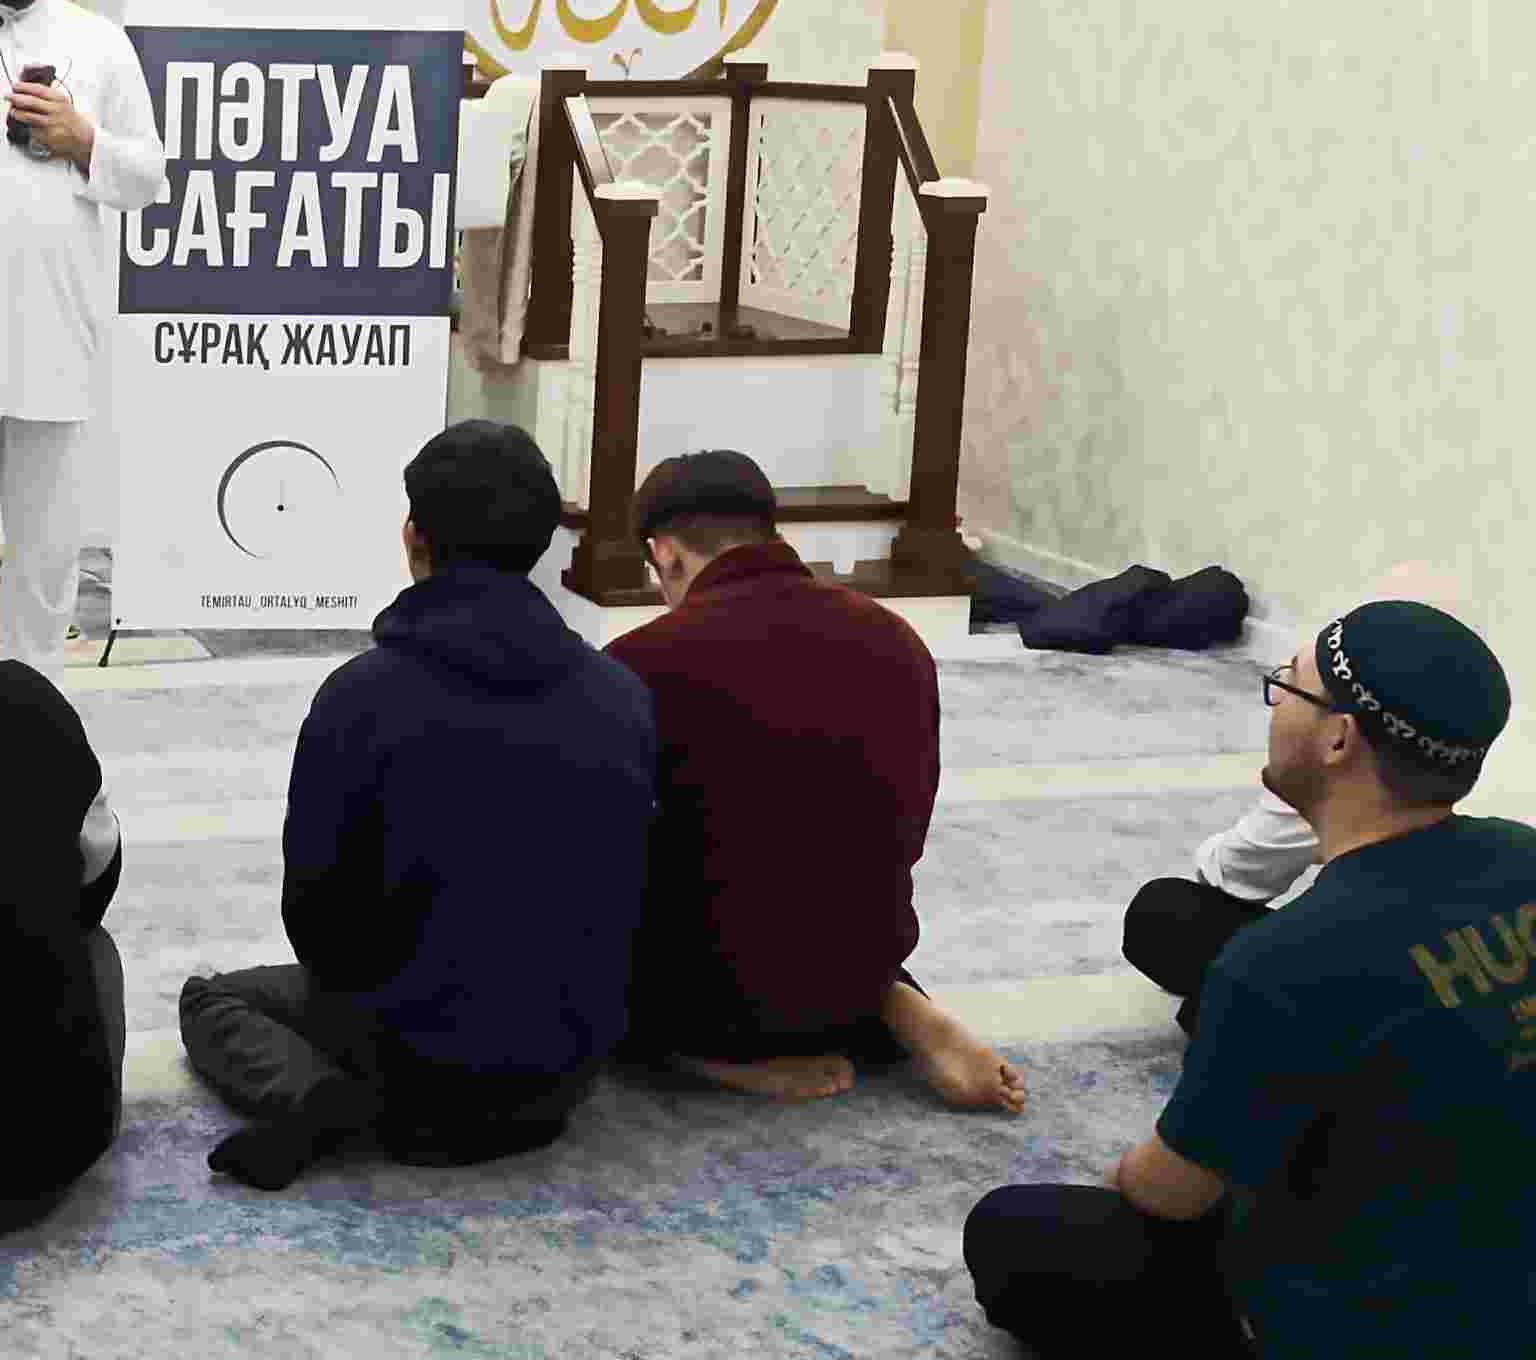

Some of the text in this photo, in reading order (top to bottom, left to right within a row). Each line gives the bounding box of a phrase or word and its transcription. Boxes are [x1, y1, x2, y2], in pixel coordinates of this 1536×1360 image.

[165, 61, 420, 163] ПӘТУА
[125, 169, 451, 269] САҒАТЫ
[154, 321, 412, 371] СҰРАҚ ЖАУАП
